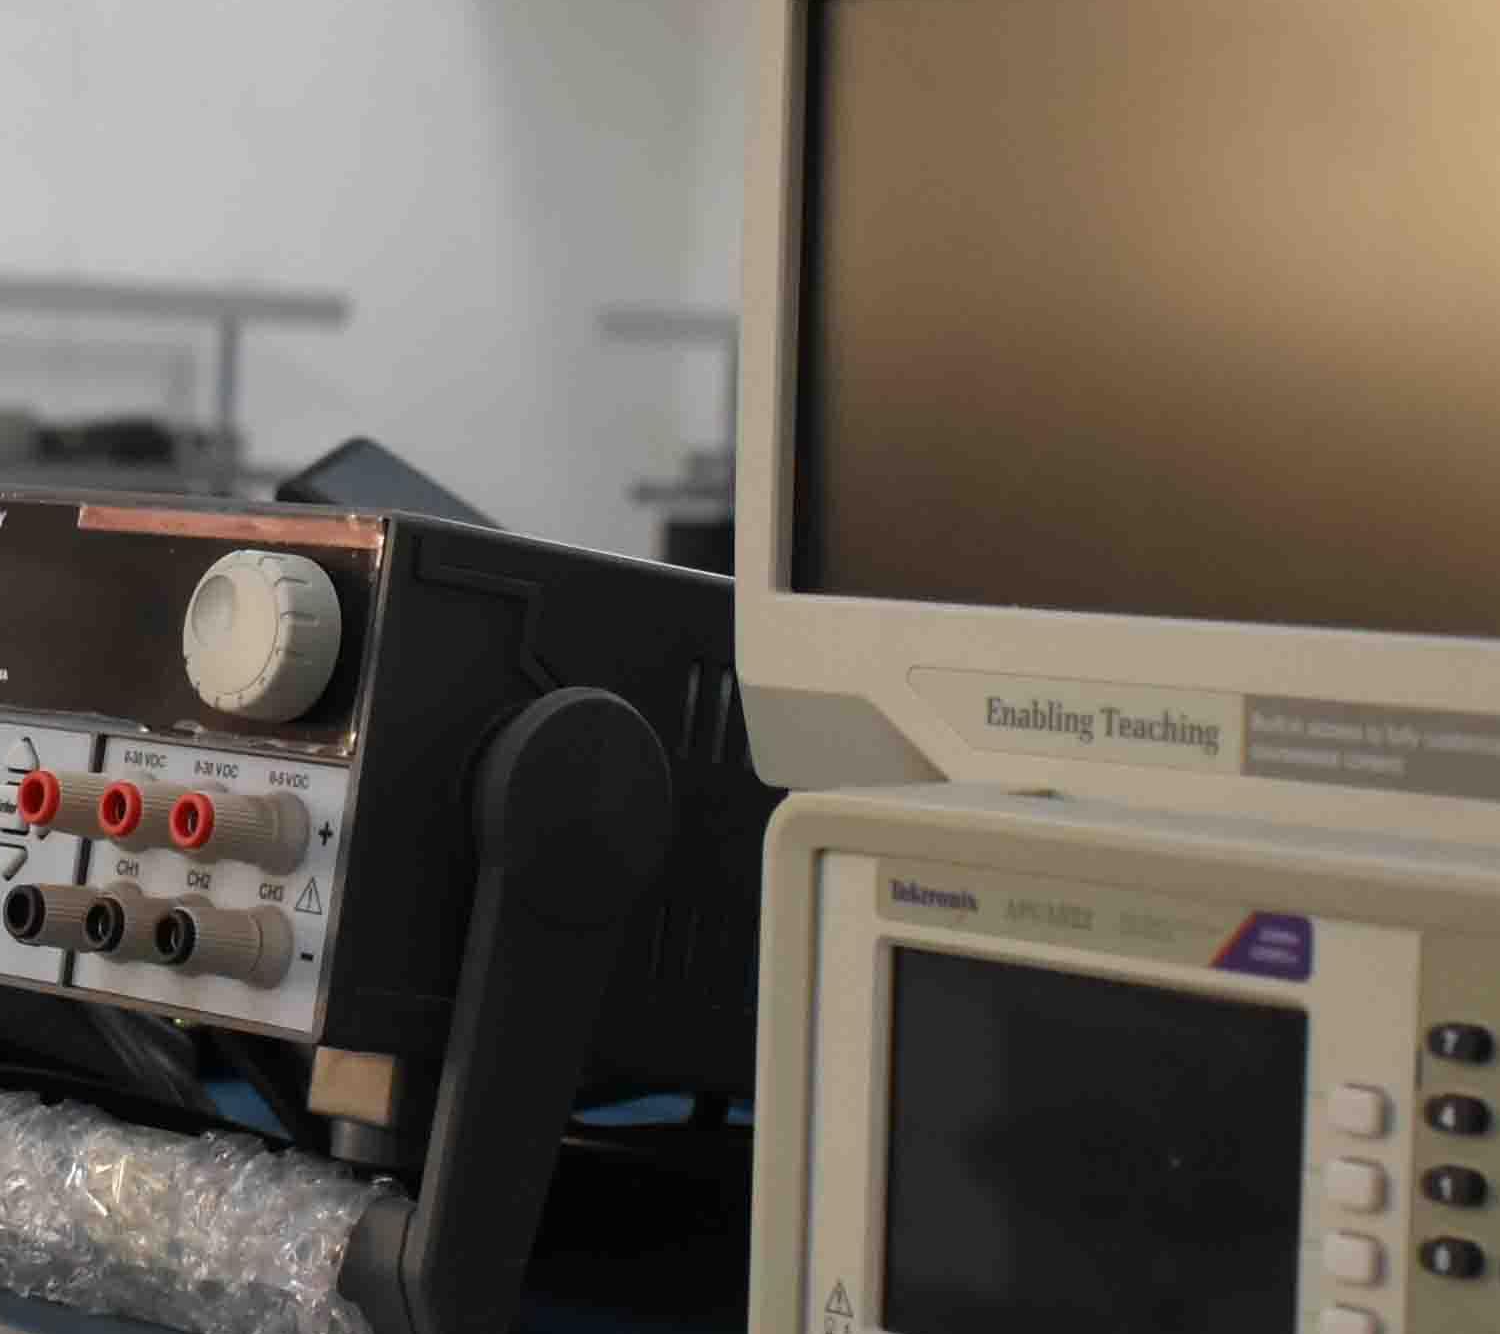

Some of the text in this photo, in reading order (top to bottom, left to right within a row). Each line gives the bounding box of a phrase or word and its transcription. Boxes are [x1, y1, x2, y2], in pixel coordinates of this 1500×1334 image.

[985, 696, 1220, 755] Enabling Teaching
[145, 752, 167, 768] VDC
[216, 764, 239, 778] VDC
[286, 773, 309, 789] VDC
[116, 859, 139, 875] CH1
[187, 870, 211, 888] CH2
[259, 882, 283, 901] CH3
[889, 879, 978, 914] Tektronix
[1443, 1029, 1459, 1053] 7
